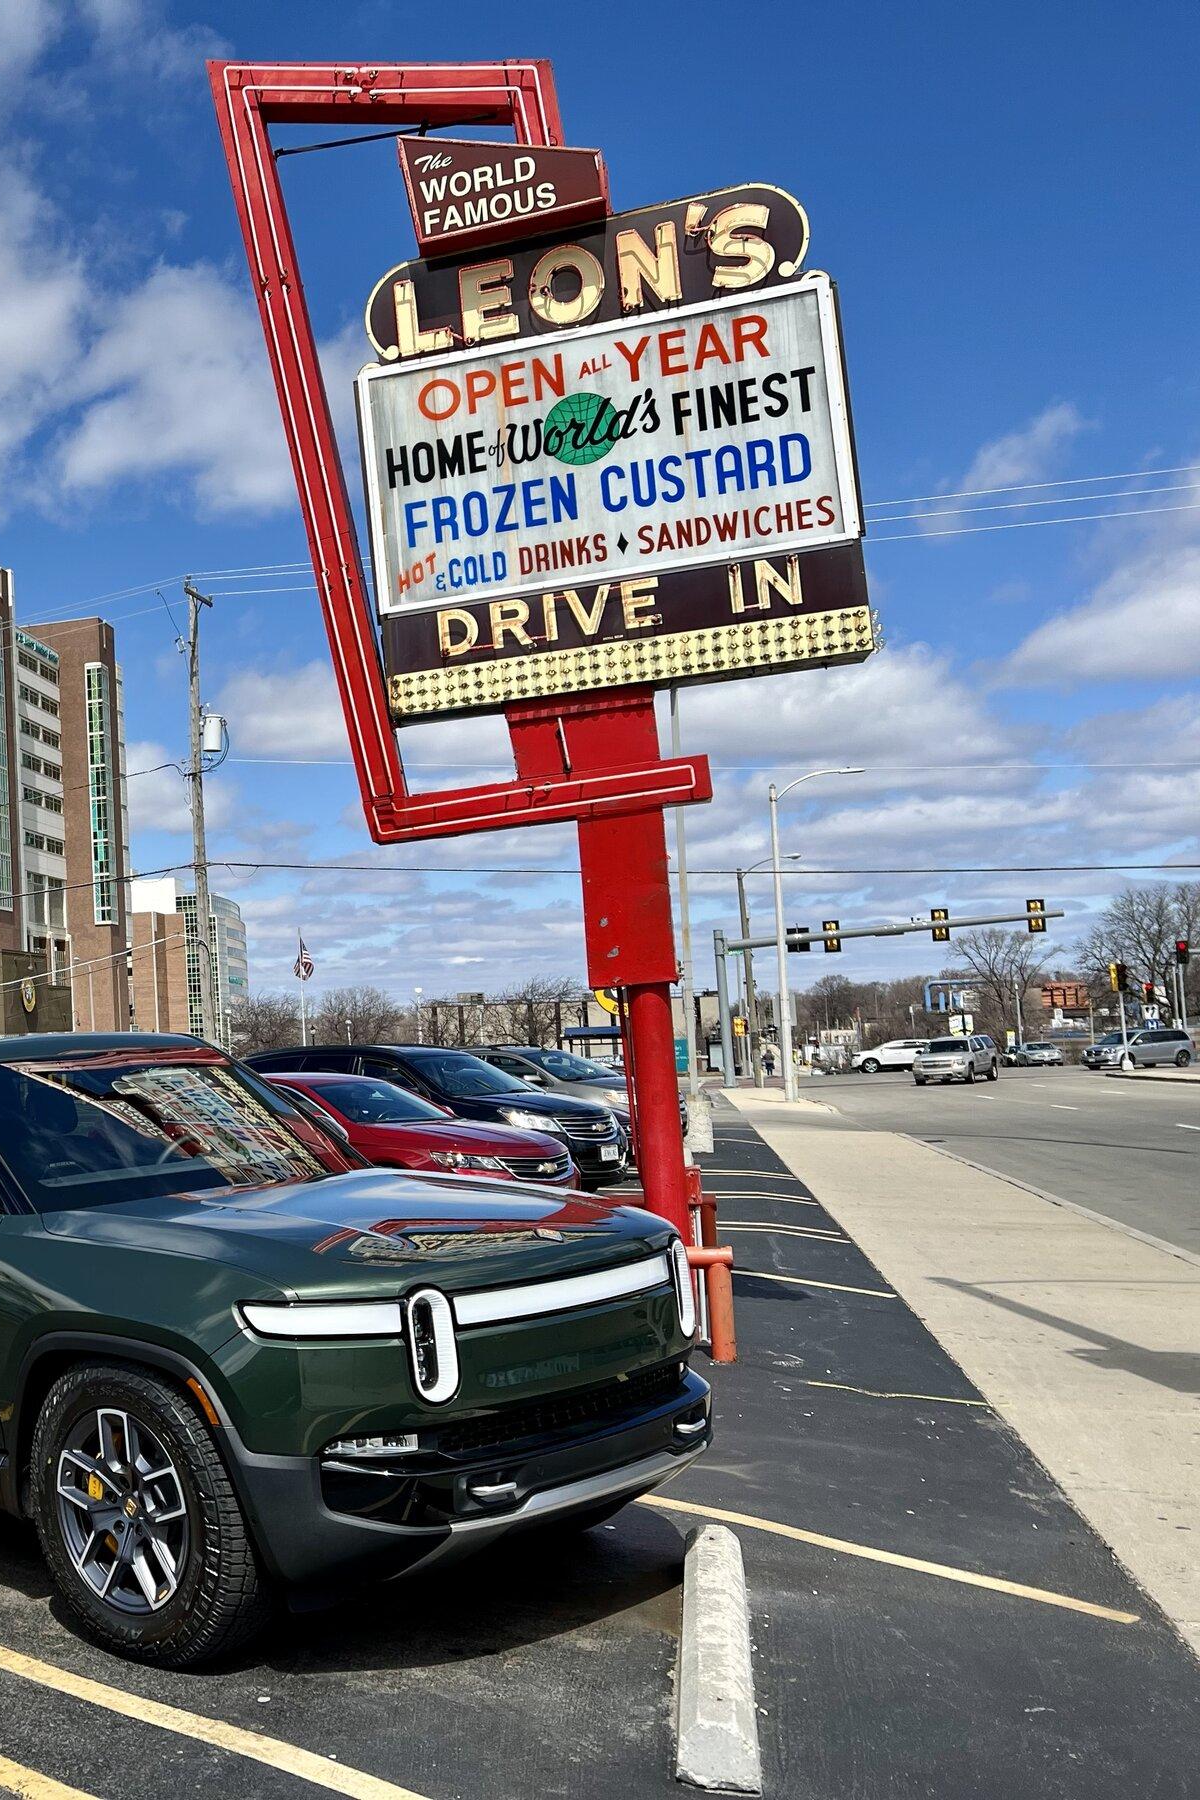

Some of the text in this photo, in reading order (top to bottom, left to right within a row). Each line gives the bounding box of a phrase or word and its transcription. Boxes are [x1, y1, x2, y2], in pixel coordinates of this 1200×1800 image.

[414, 152, 453, 171] The
[420, 155, 538, 205] WORLD
[423, 182, 557, 235] FAMOUS
[392, 202, 776, 358] LEON'S
[418, 313, 772, 421] OPEN ALL YEAR
[387, 366, 816, 490] HOME of World's FINEST
[404, 432, 813, 548] FROZEN CUSTARD
[397, 551, 437, 595] HOT
[447, 549, 507, 589] COLD
[517, 531, 608, 576] DRINKS
[637, 495, 837, 556] SANDWICHES
[436, 554, 805, 658] DRIVE IN
